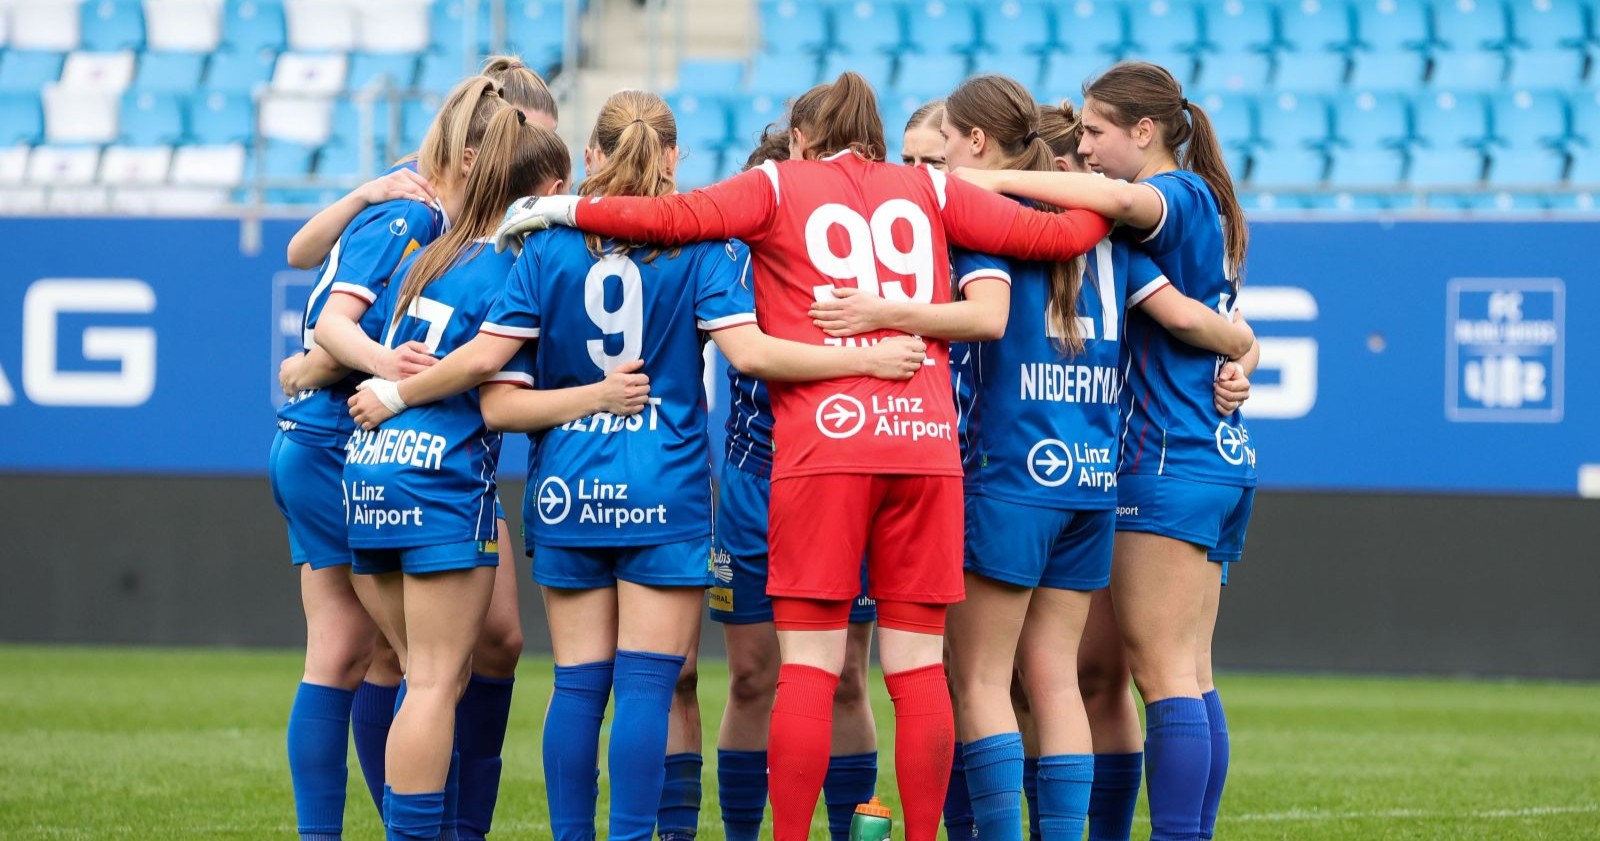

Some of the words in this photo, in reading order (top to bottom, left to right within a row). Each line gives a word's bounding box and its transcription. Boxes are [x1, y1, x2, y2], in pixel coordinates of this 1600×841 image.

[804, 198, 934, 305] 99
[584, 254, 643, 376] 9
[872, 394, 923, 414] Linz
[874, 415, 952, 441] Airport
[1075, 442, 1110, 463] Linz
[353, 480, 385, 501] Linz
[578, 479, 628, 500] Linz
[353, 504, 423, 530] Airport
[579, 503, 667, 529] Airport
